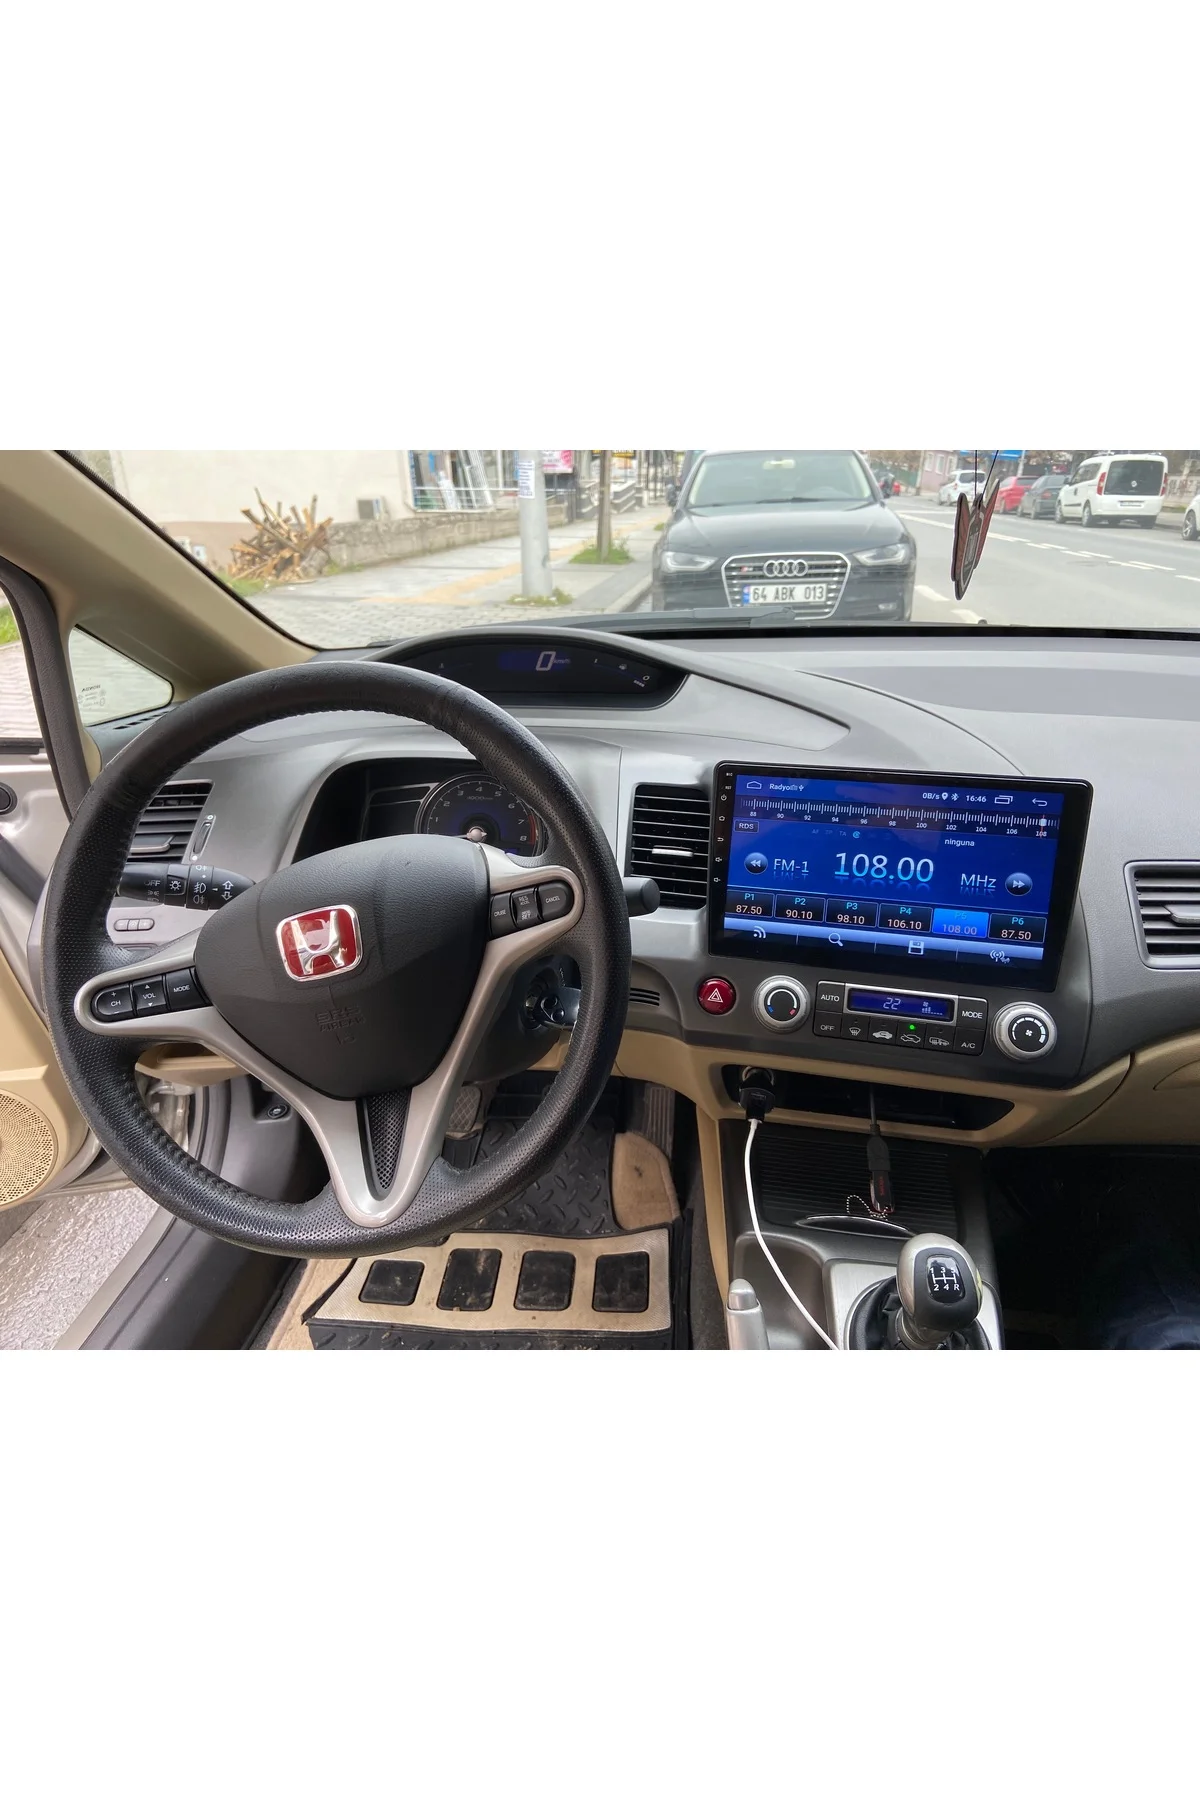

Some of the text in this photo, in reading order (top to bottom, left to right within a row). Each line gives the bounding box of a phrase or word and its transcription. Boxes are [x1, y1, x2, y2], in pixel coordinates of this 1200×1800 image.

[752, 585, 824, 601] 64 ABK 013
[535, 651, 556, 671] 0
[769, 783, 790, 792] Radyo
[965, 795, 987, 803] 16:46
[738, 822, 754, 830] RDS
[944, 838, 975, 847] ninguna
[773, 858, 810, 873] FM-1
[834, 852, 935, 882] 108.00
[960, 873, 997, 888] MHz
[744, 892, 755, 901] P1
[794, 897, 806, 906] P2
[846, 901, 858, 910] P3
[735, 904, 763, 915] 87.50
[899, 906, 912, 915] P4
[785, 909, 813, 920] 90.10
[837, 913, 865, 925] 98.10
[954, 912, 967, 920] P5
[887, 918, 922, 930] 106.10
[1011, 916, 1024, 926] P6
[942, 923, 978, 936] 108.00
[1001, 929, 1032, 941] 87.50
[173, 984, 190, 993] MODE
[142, 992, 156, 1000] VOL
[820, 993, 840, 1002] AUTO
[882, 997, 901, 1011] 22
[961, 1010, 983, 1020] MODE
[960, 1041, 976, 1049] A/C
[933, 1283, 960, 1291] 2 4 R
